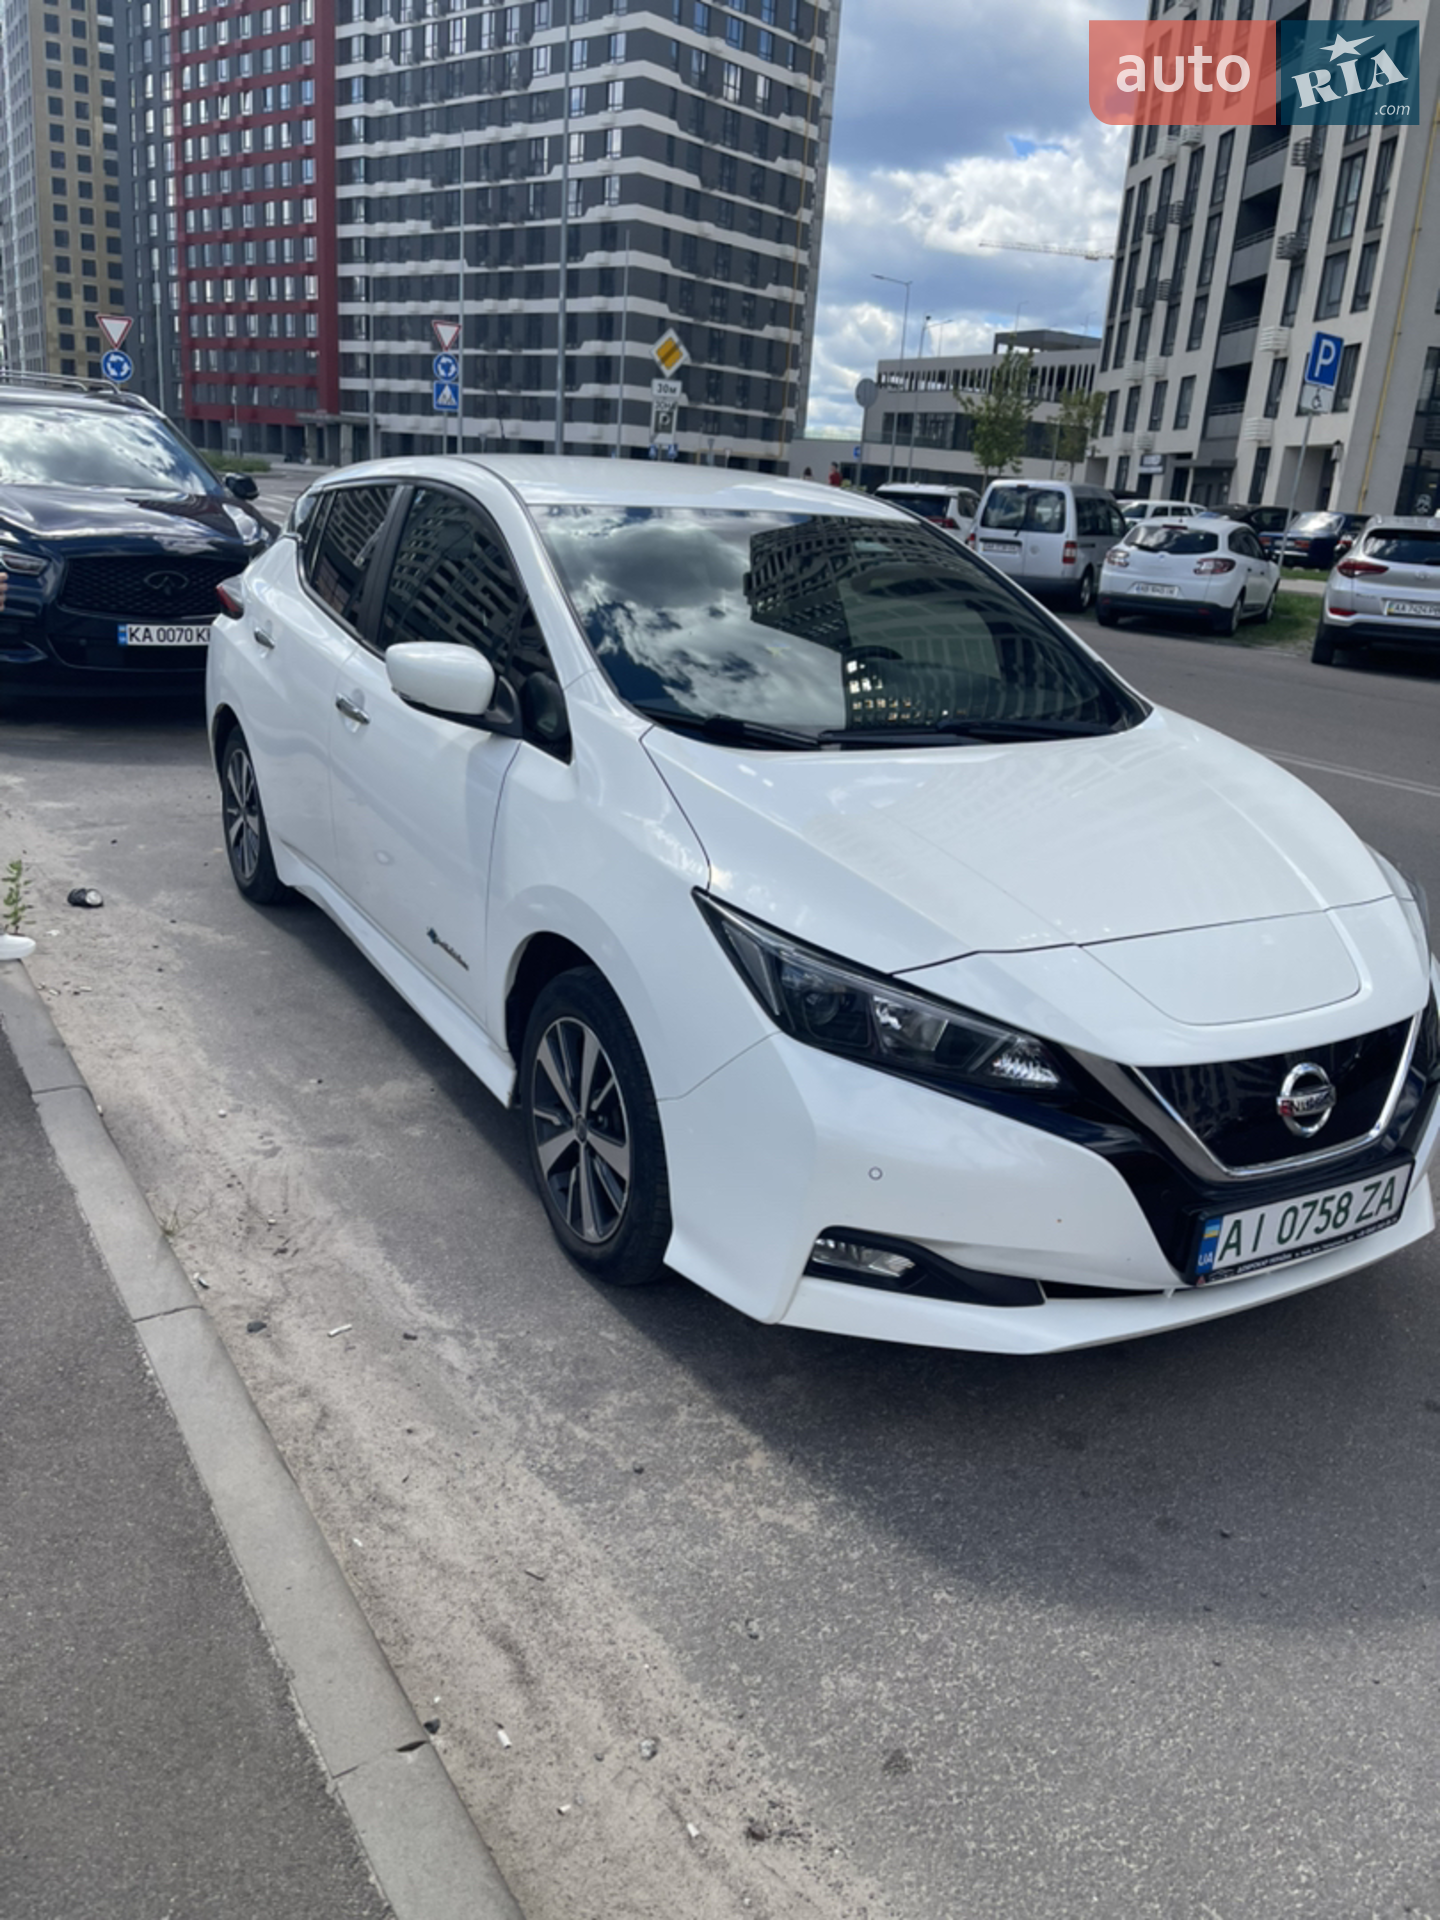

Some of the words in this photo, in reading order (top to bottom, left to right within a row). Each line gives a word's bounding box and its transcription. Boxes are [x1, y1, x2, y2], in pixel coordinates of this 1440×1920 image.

[1314, 339, 1336, 378] P
[128, 626, 153, 643] KA
[156, 626, 194, 643] 0070
[196, 627, 211, 643] K
[1218, 1213, 1265, 1261] AI
[1276, 1191, 1353, 1245] 0758
[1355, 1176, 1396, 1224] ZA
[1198, 1252, 1214, 1266] UA
